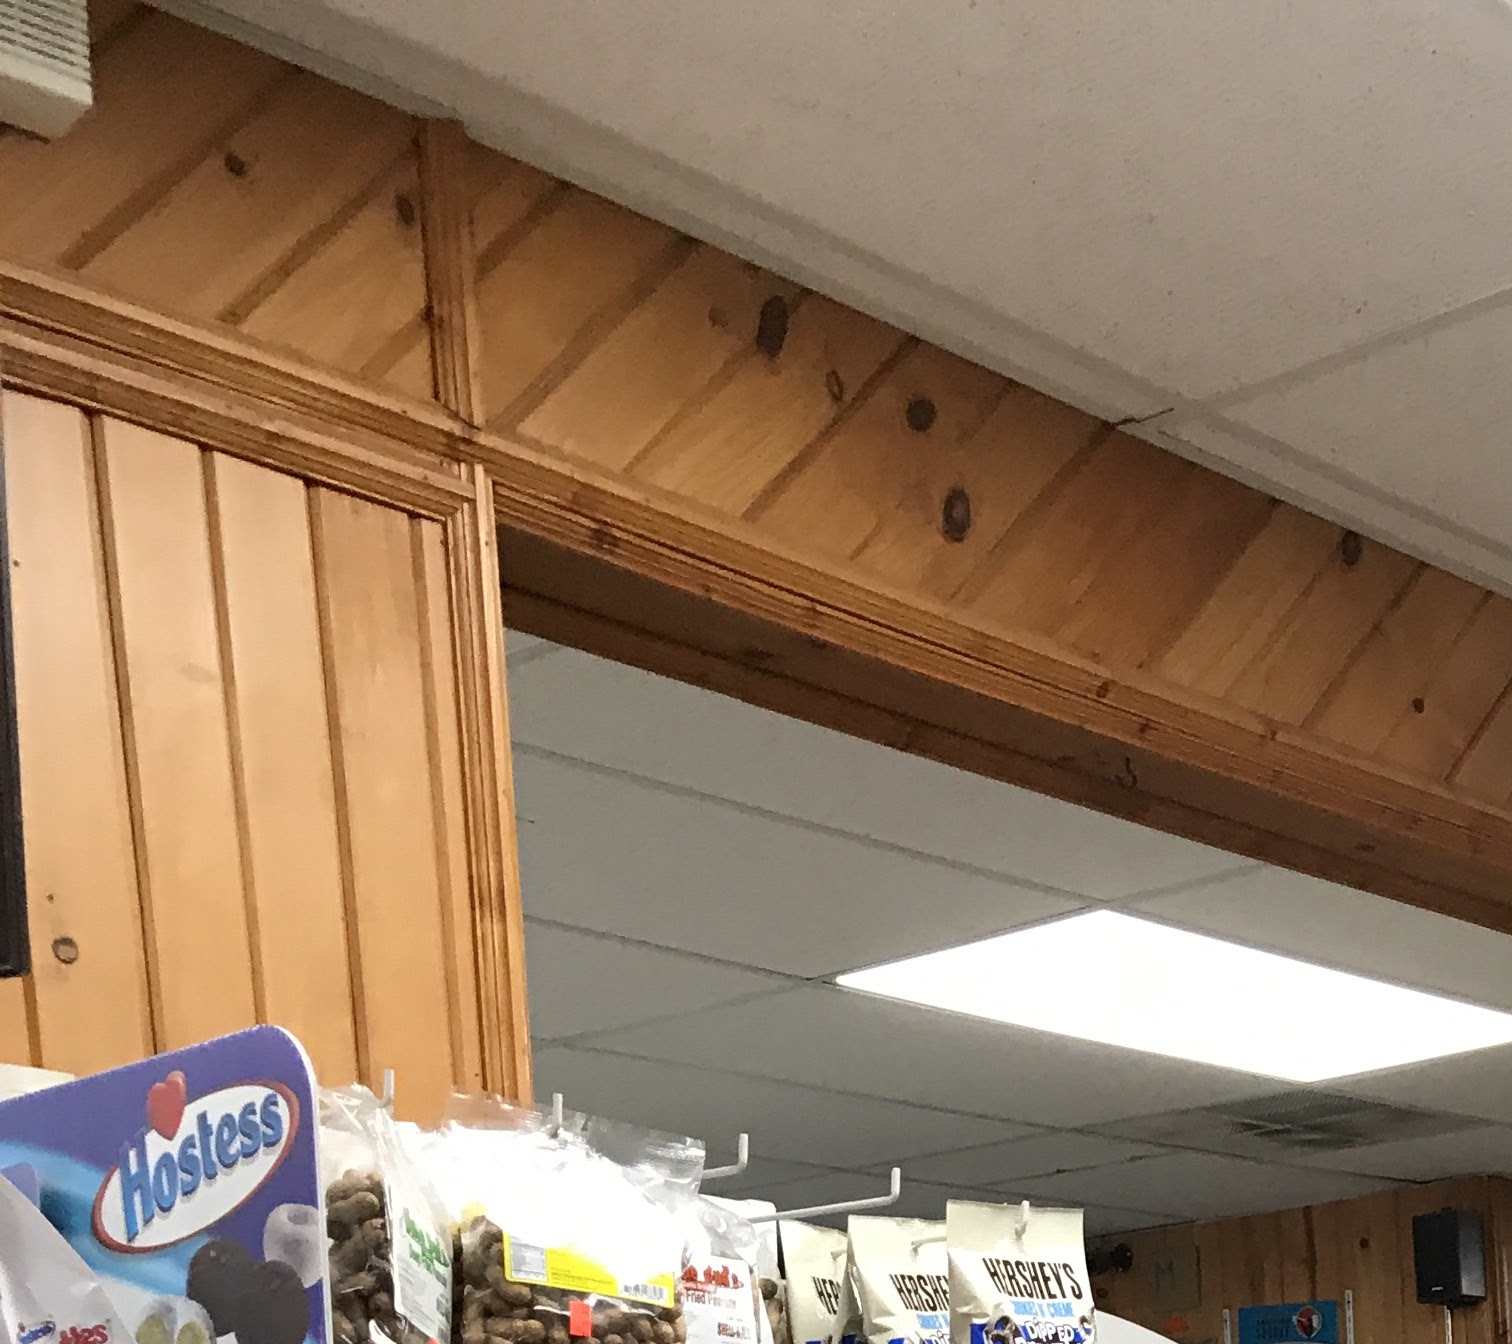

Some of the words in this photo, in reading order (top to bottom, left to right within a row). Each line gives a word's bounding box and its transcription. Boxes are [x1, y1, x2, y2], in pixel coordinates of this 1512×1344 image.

[119, 1092, 284, 1243] Hostess
[889, 1273, 950, 1313] HERSHE
[982, 1257, 1084, 1300] HERSHEY'S
